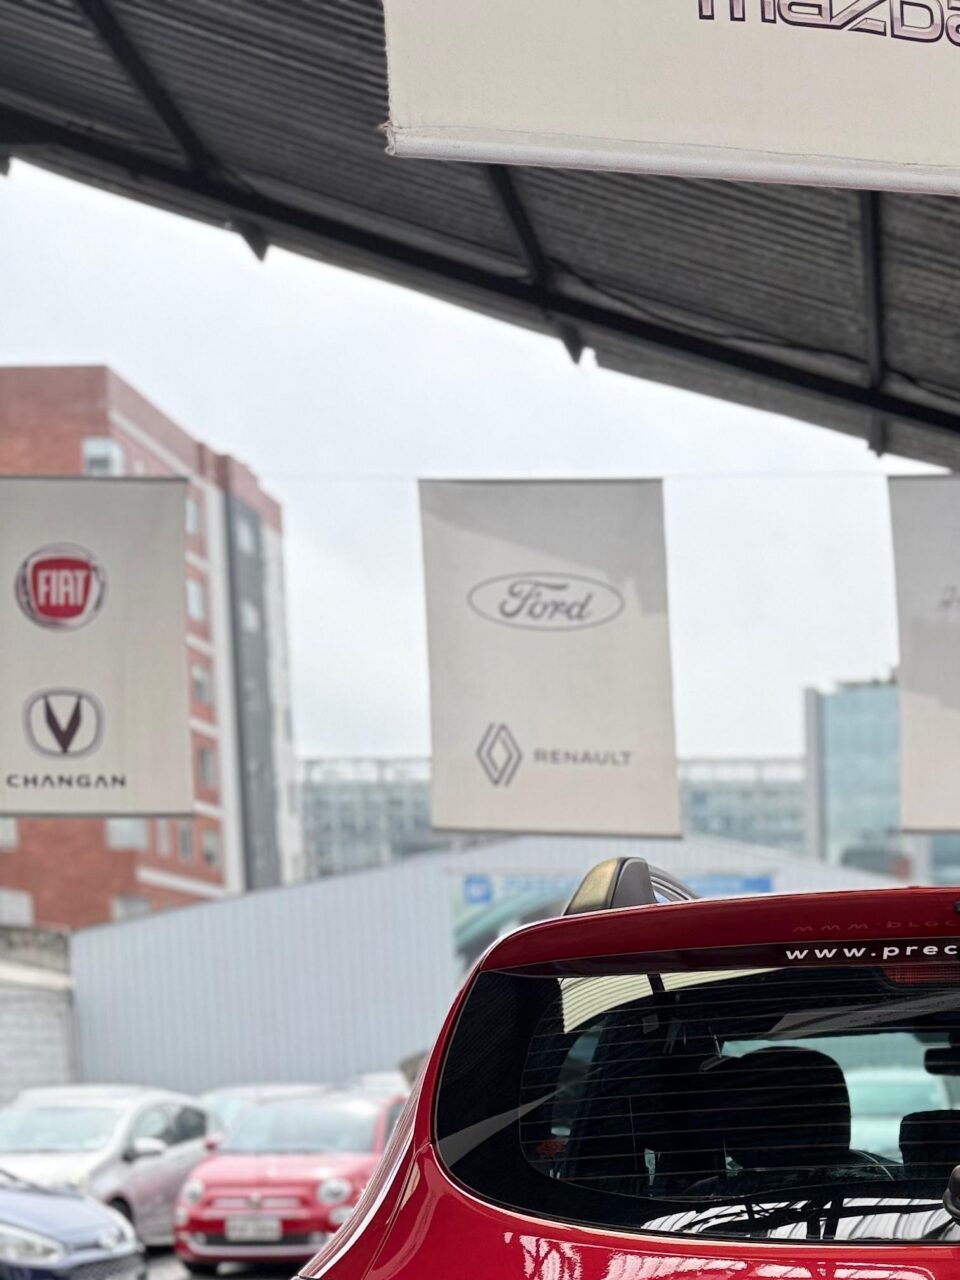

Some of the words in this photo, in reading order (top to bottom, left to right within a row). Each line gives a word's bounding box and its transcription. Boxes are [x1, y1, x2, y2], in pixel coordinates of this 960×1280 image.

[38, 568, 88, 606] FIAT
[498, 578, 594, 621] Ford
[533, 748, 632, 765] RENAULT
[6, 774, 127, 788] CHANGAN
